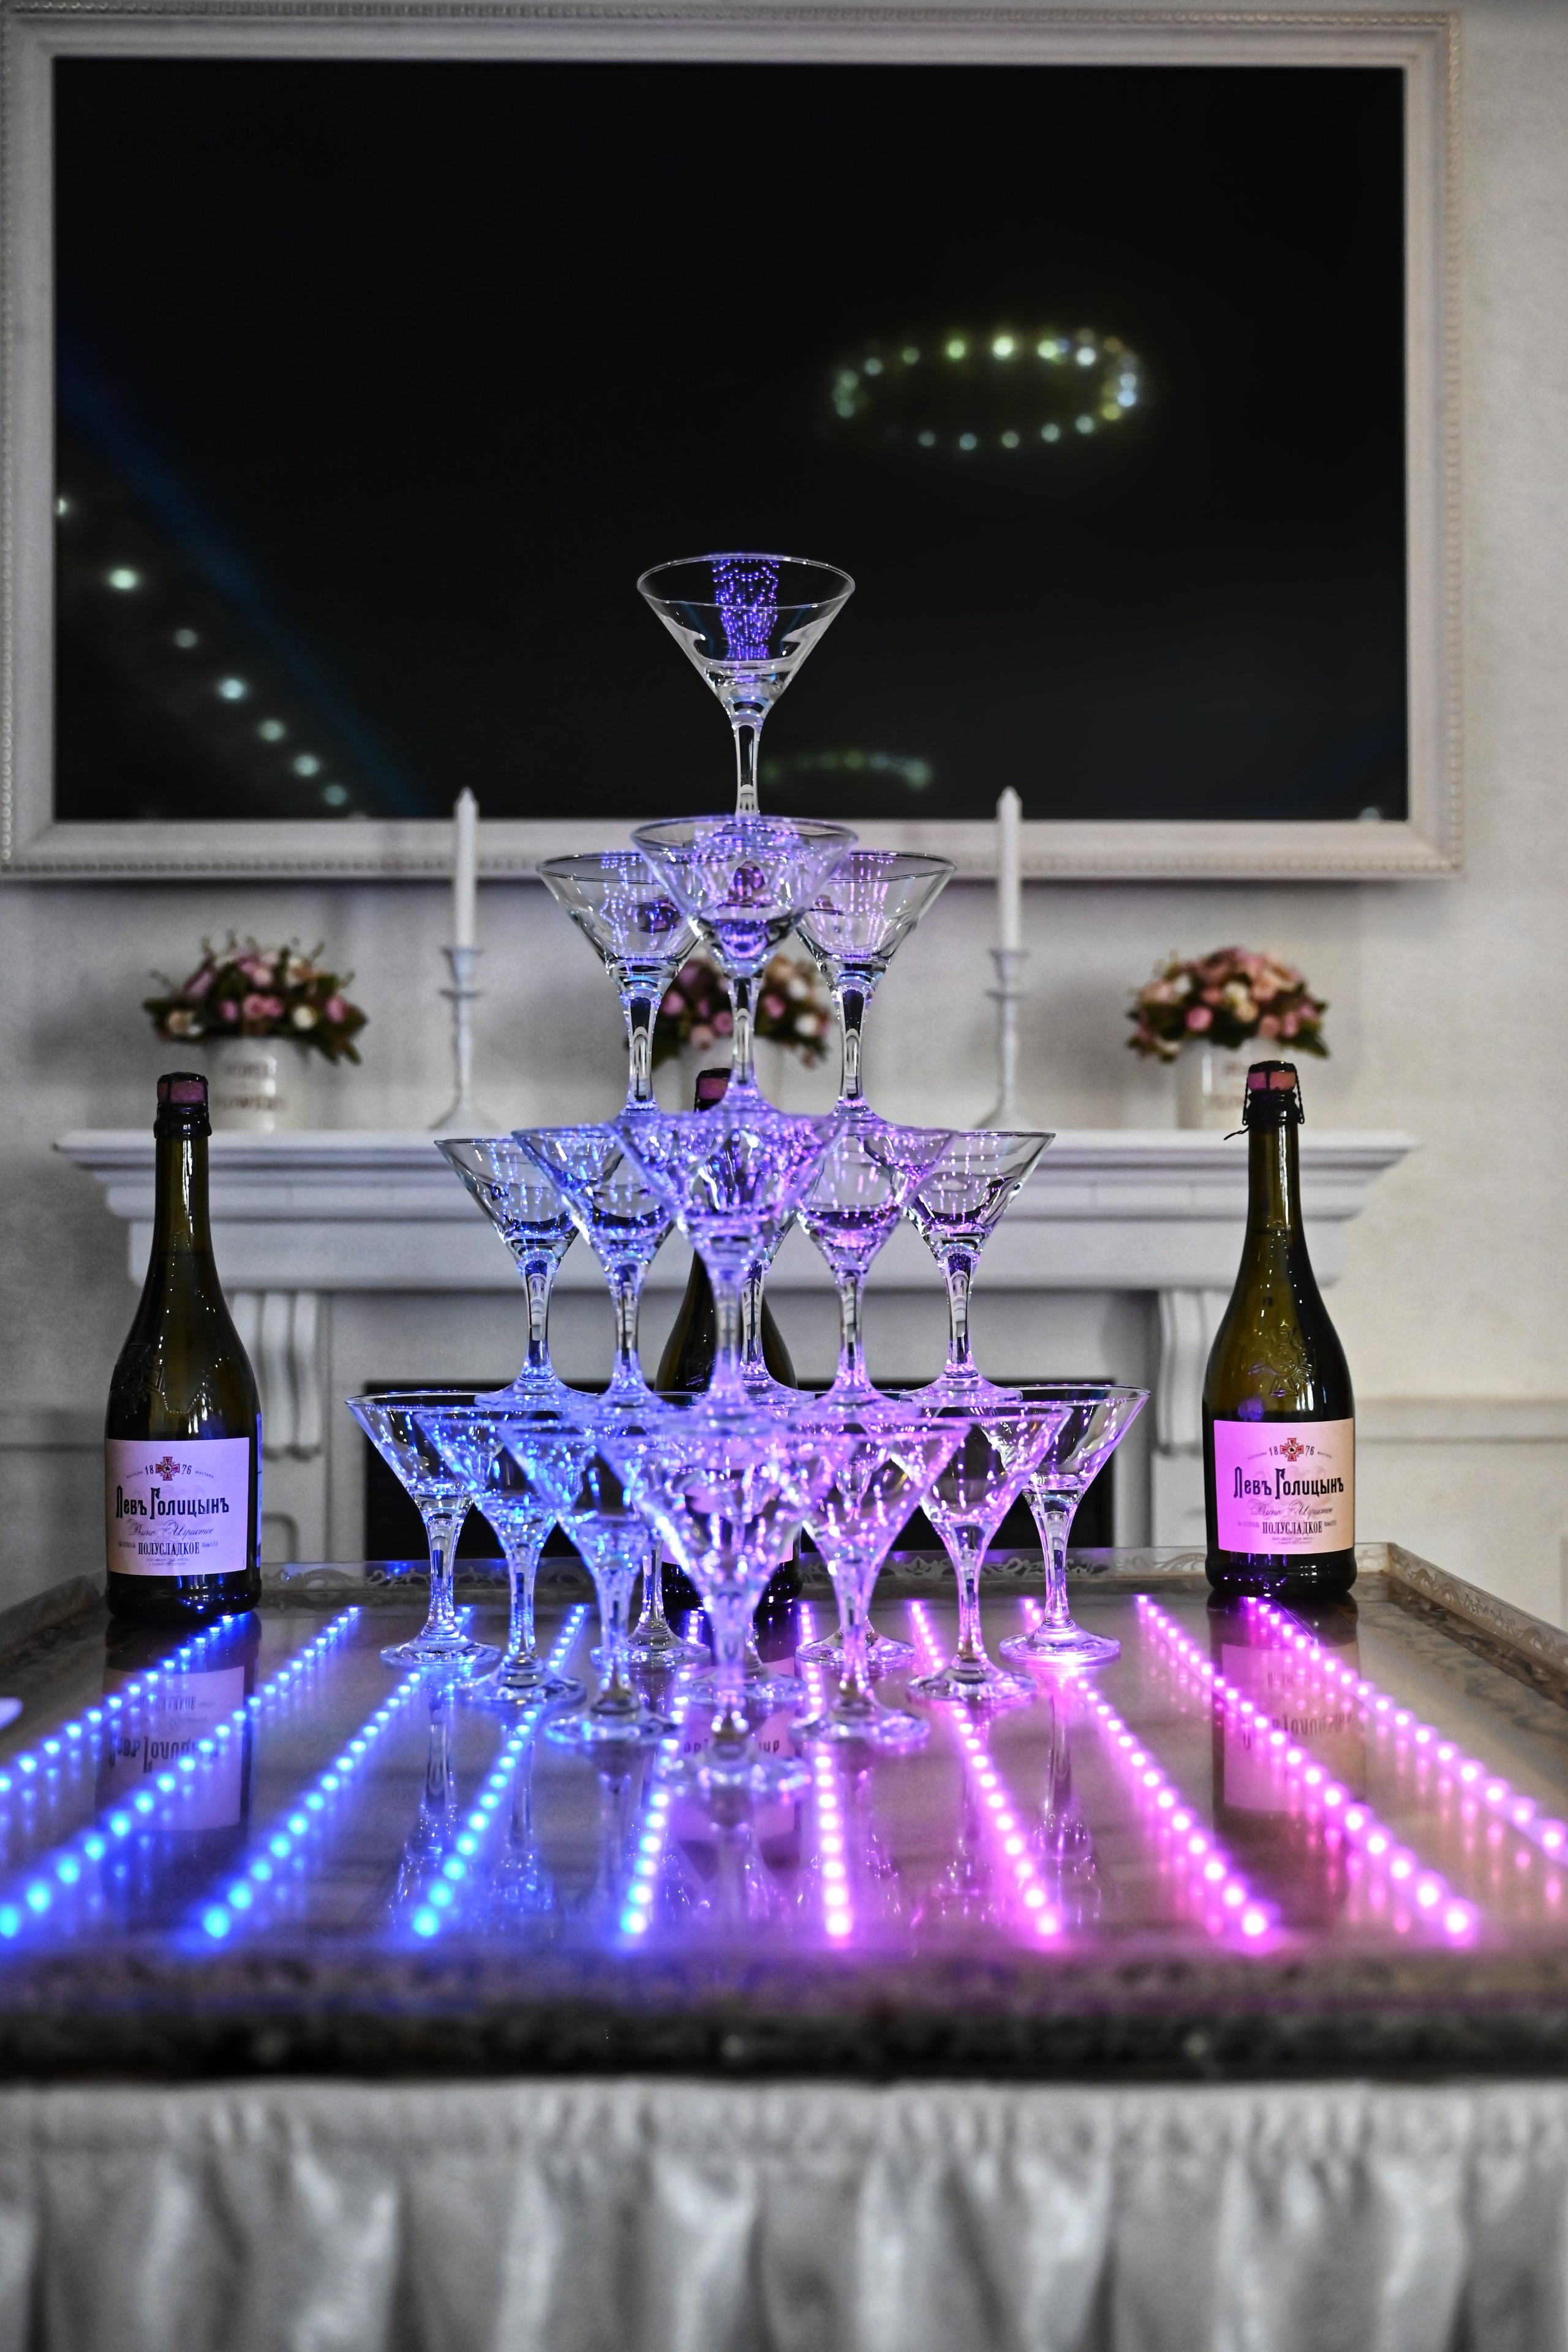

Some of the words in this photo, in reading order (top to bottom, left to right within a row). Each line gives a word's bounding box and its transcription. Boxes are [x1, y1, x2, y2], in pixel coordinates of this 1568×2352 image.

[1268, 1446, 1279, 1456] 18
[1306, 1446, 1315, 1457] 76
[145, 1464, 154, 1475] 18
[182, 1464, 192, 1475] 76
[1234, 1466, 1272, 1498] Левъ
[1275, 1468, 1344, 1499] Голицынъ
[116, 1485, 147, 1518] Левъ
[150, 1487, 230, 1520] Голицынъ
[1262, 1521, 1322, 1536] ПОЛУСЛАДКОЕ
[138, 1542, 200, 1557] ПОЛУСЛАДКОЕ
